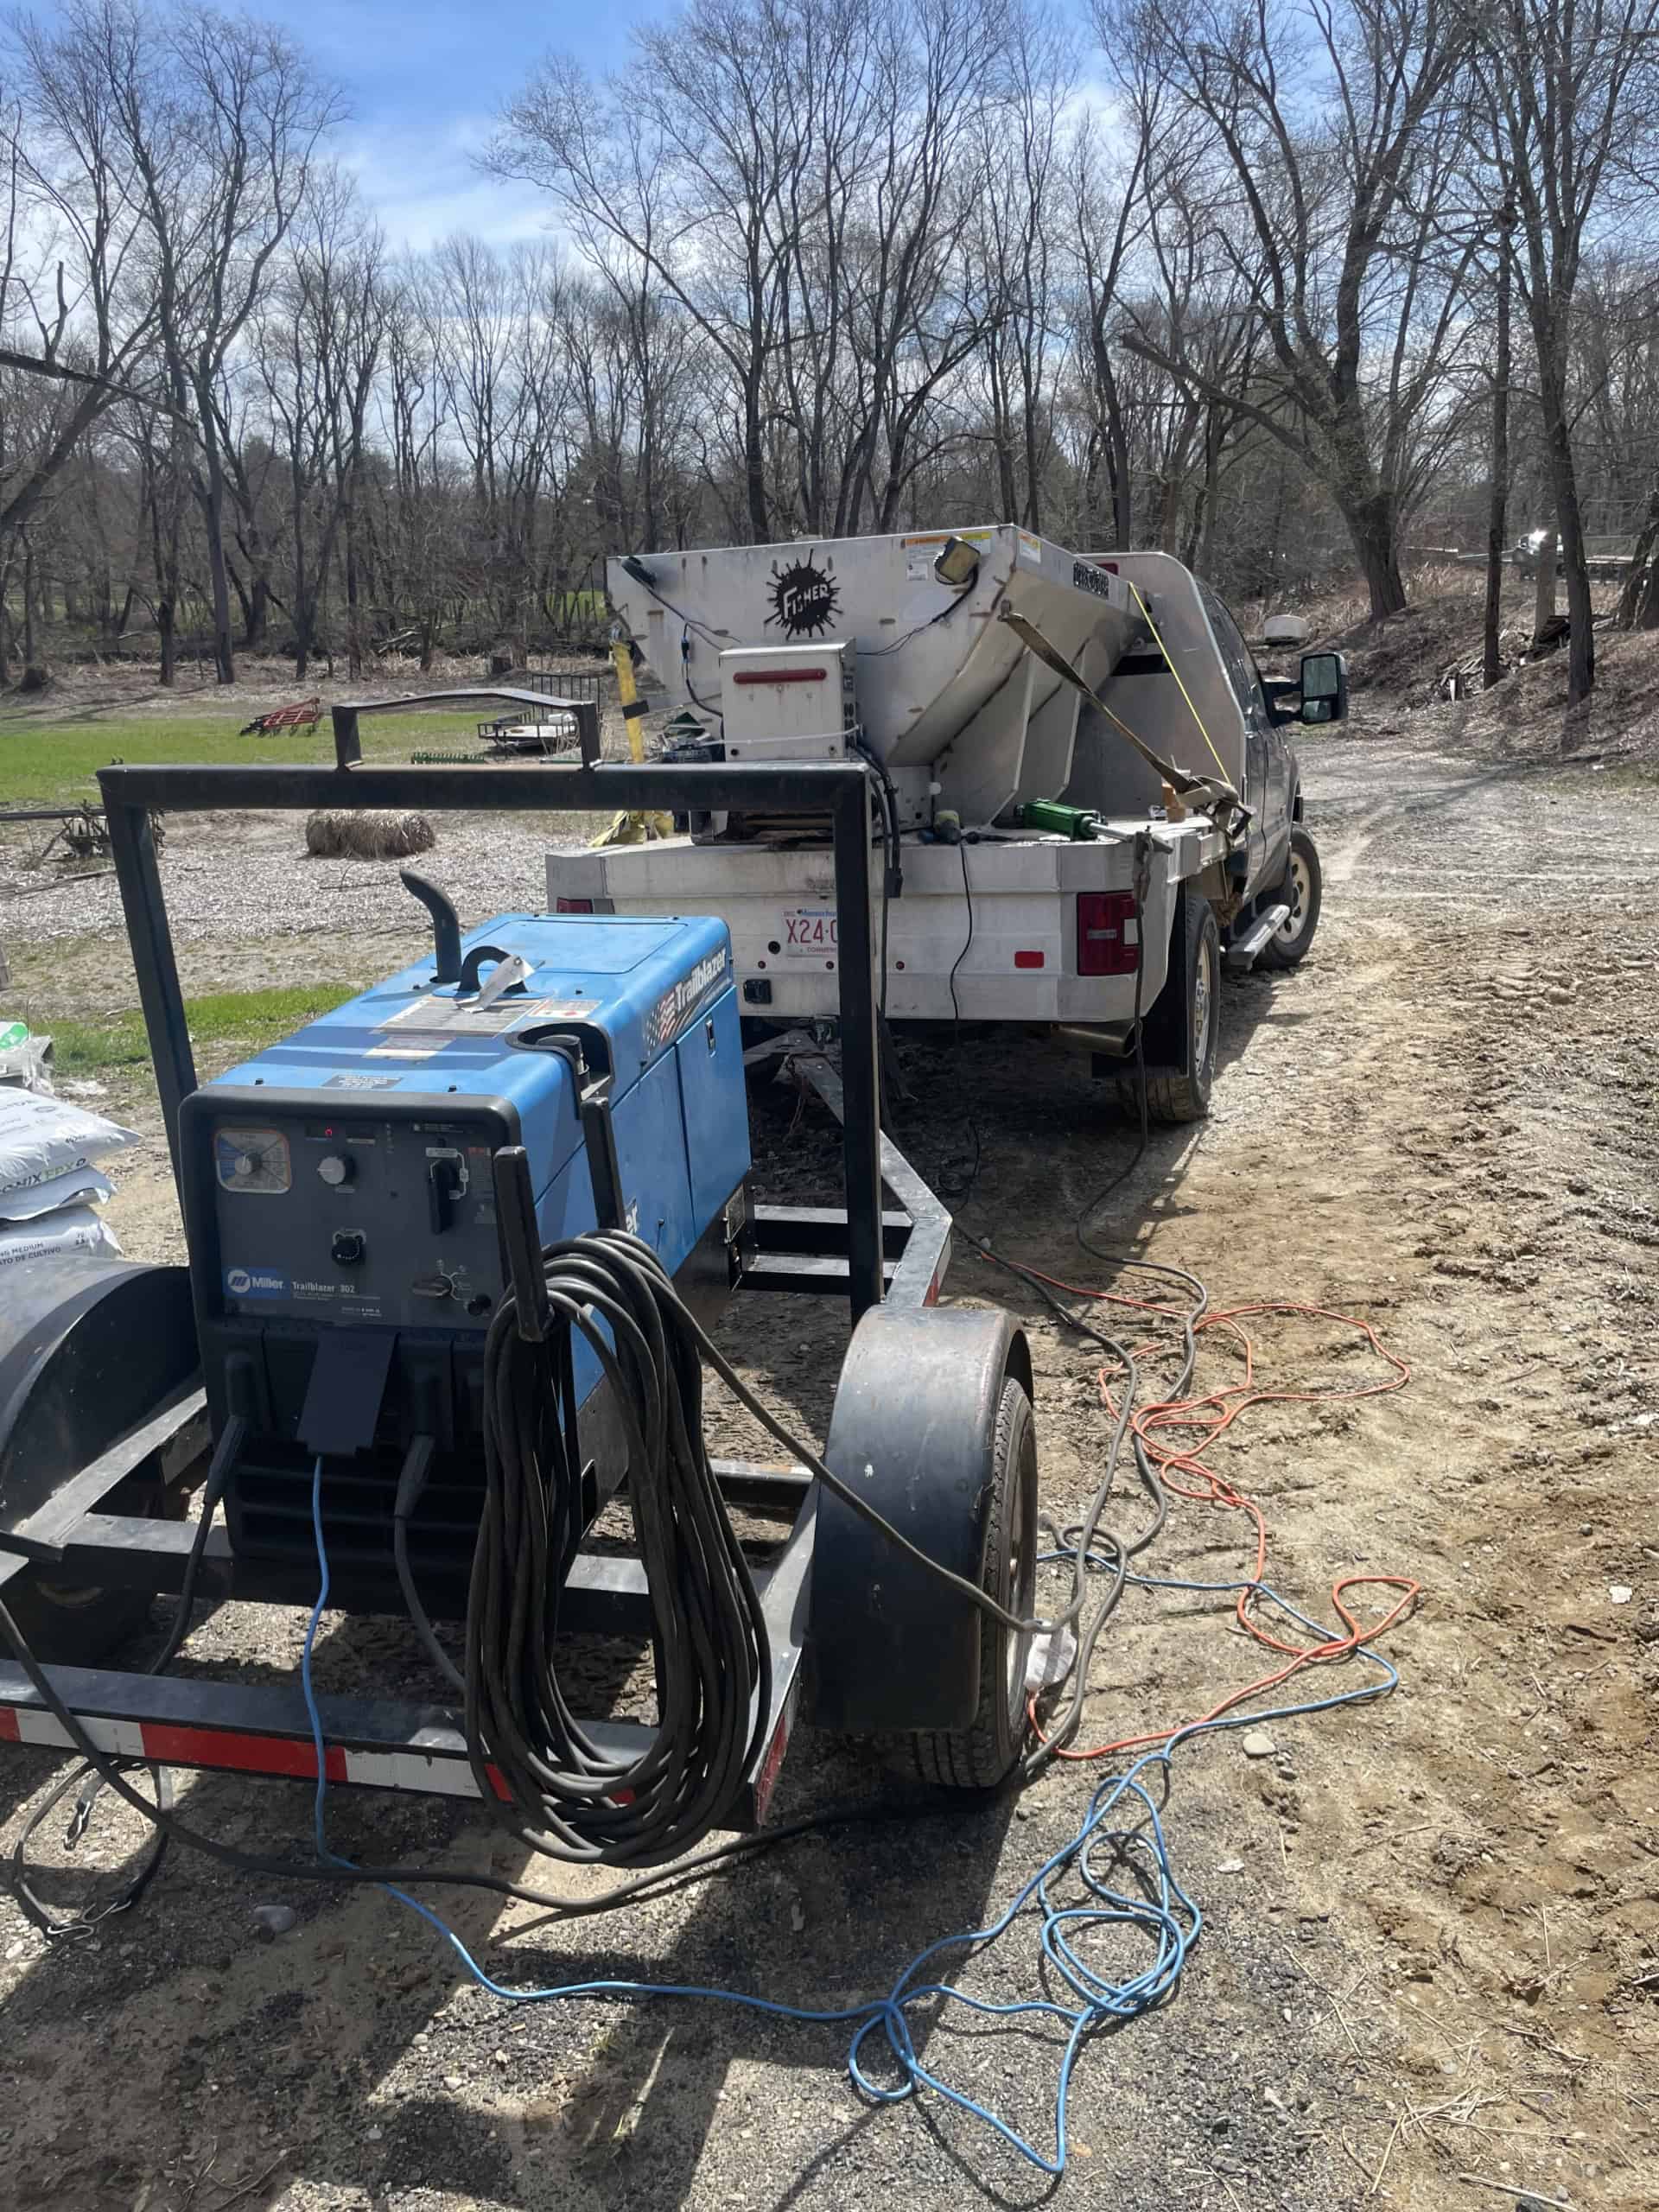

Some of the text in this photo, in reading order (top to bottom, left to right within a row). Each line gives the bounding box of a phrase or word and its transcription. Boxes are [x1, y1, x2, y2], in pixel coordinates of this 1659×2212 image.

[783, 583, 830, 620] FISHER
[676, 947, 726, 1012] Trailblazer
[28, 1245, 62, 1259] CULTIVO
[251, 1276, 284, 1290] Miller
[291, 1281, 336, 1294] Trailblazer
